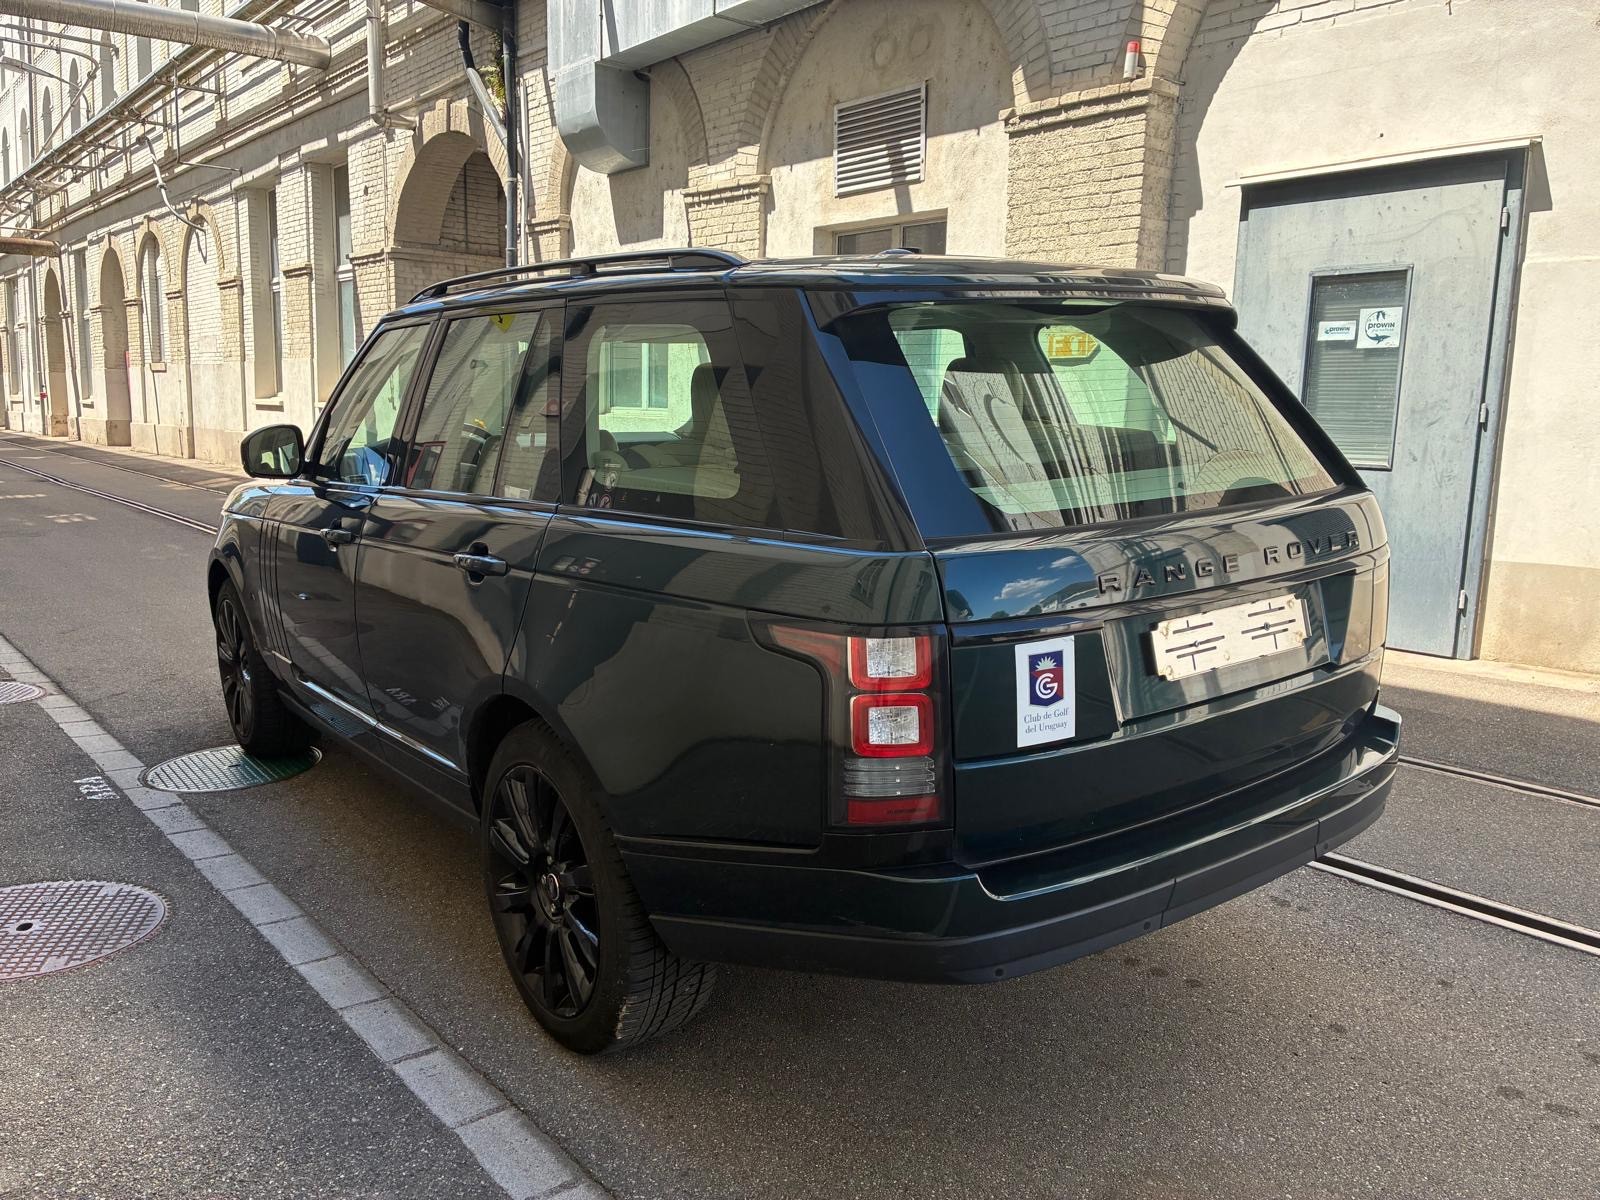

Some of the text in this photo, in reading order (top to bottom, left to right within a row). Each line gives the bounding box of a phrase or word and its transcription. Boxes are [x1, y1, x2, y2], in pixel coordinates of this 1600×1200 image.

[1097, 530, 1361, 595] RANGE ROVER
[1023, 707, 1069, 724] Club de Golf
[1025, 721, 1068, 734] del Uruguay
